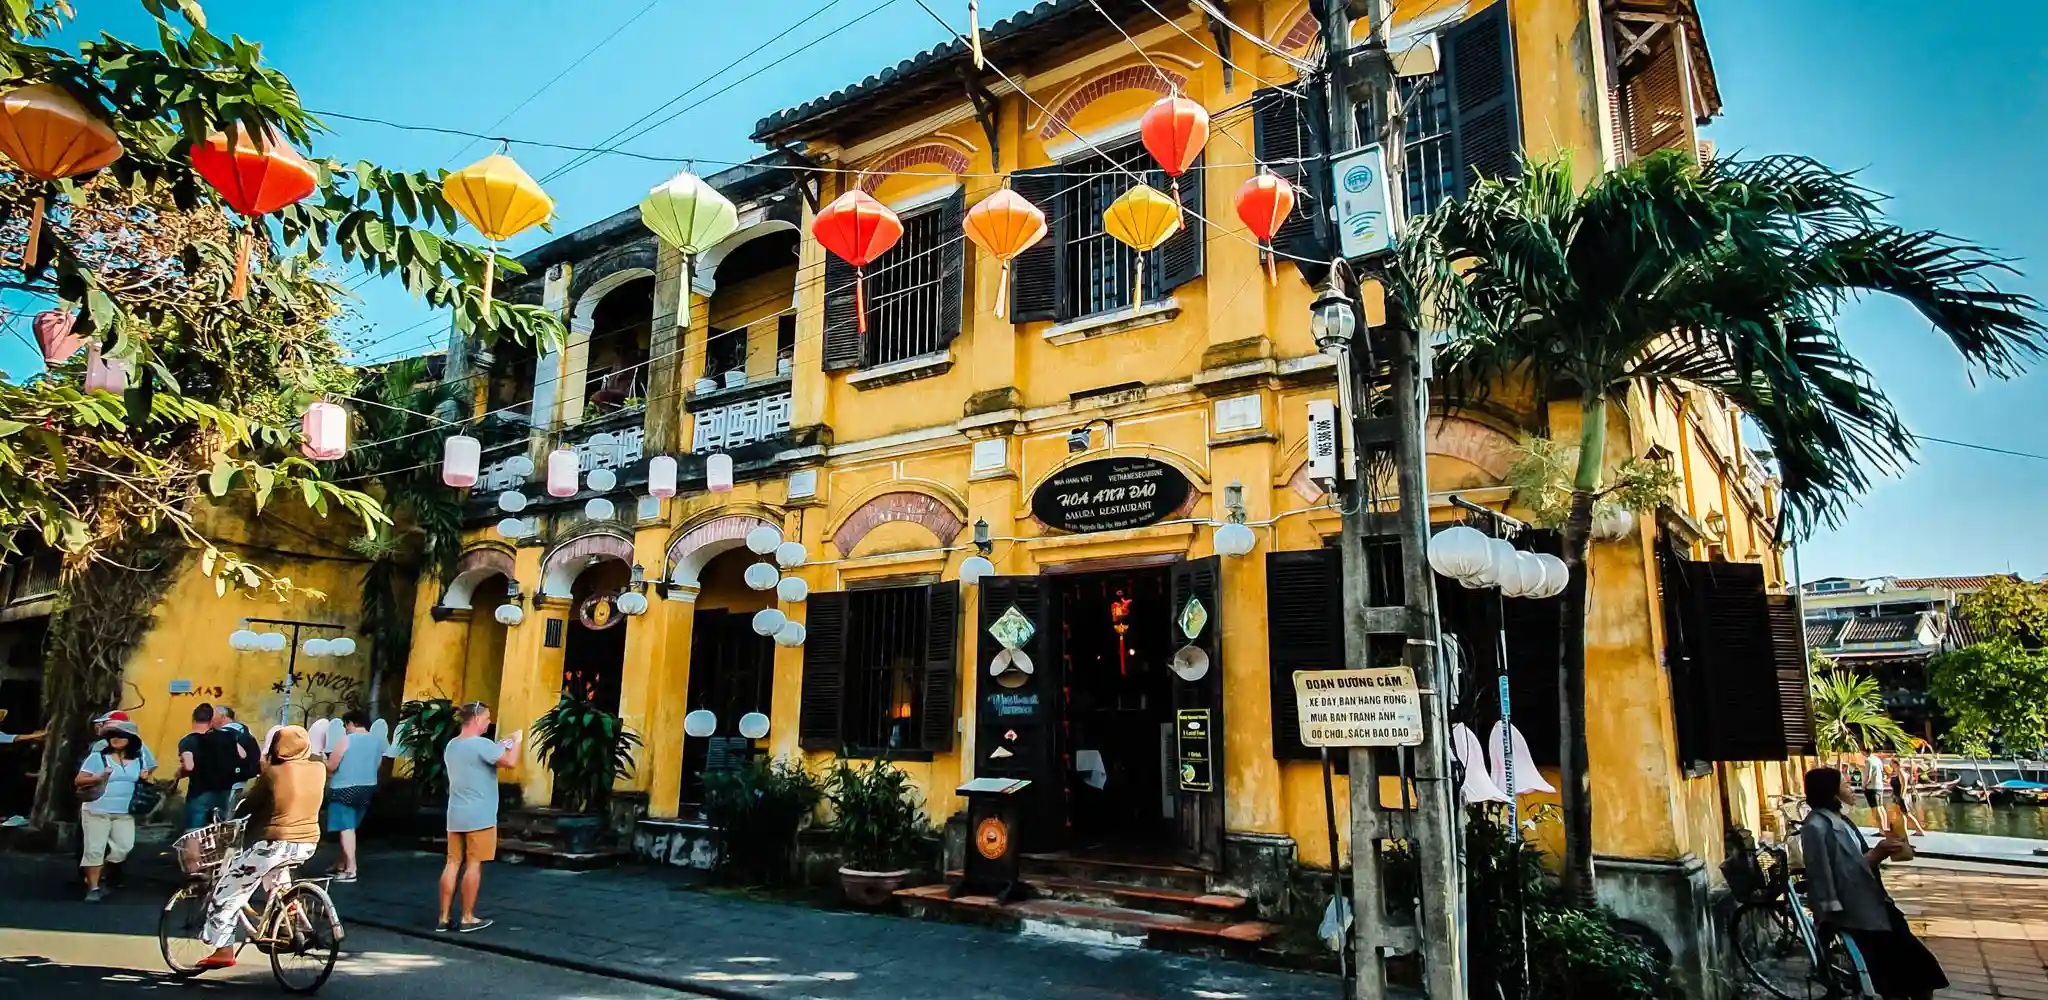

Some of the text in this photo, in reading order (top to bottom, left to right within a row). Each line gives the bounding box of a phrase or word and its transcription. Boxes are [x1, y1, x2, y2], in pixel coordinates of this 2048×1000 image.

[1057, 491, 1089, 507] HOA
[1092, 486, 1126, 503] ANH
[1065, 501, 1152, 520] SAKURA RESTAURANT
[1310, 713, 1328, 723] MUA
[1349, 712, 1376, 722] TRANH
